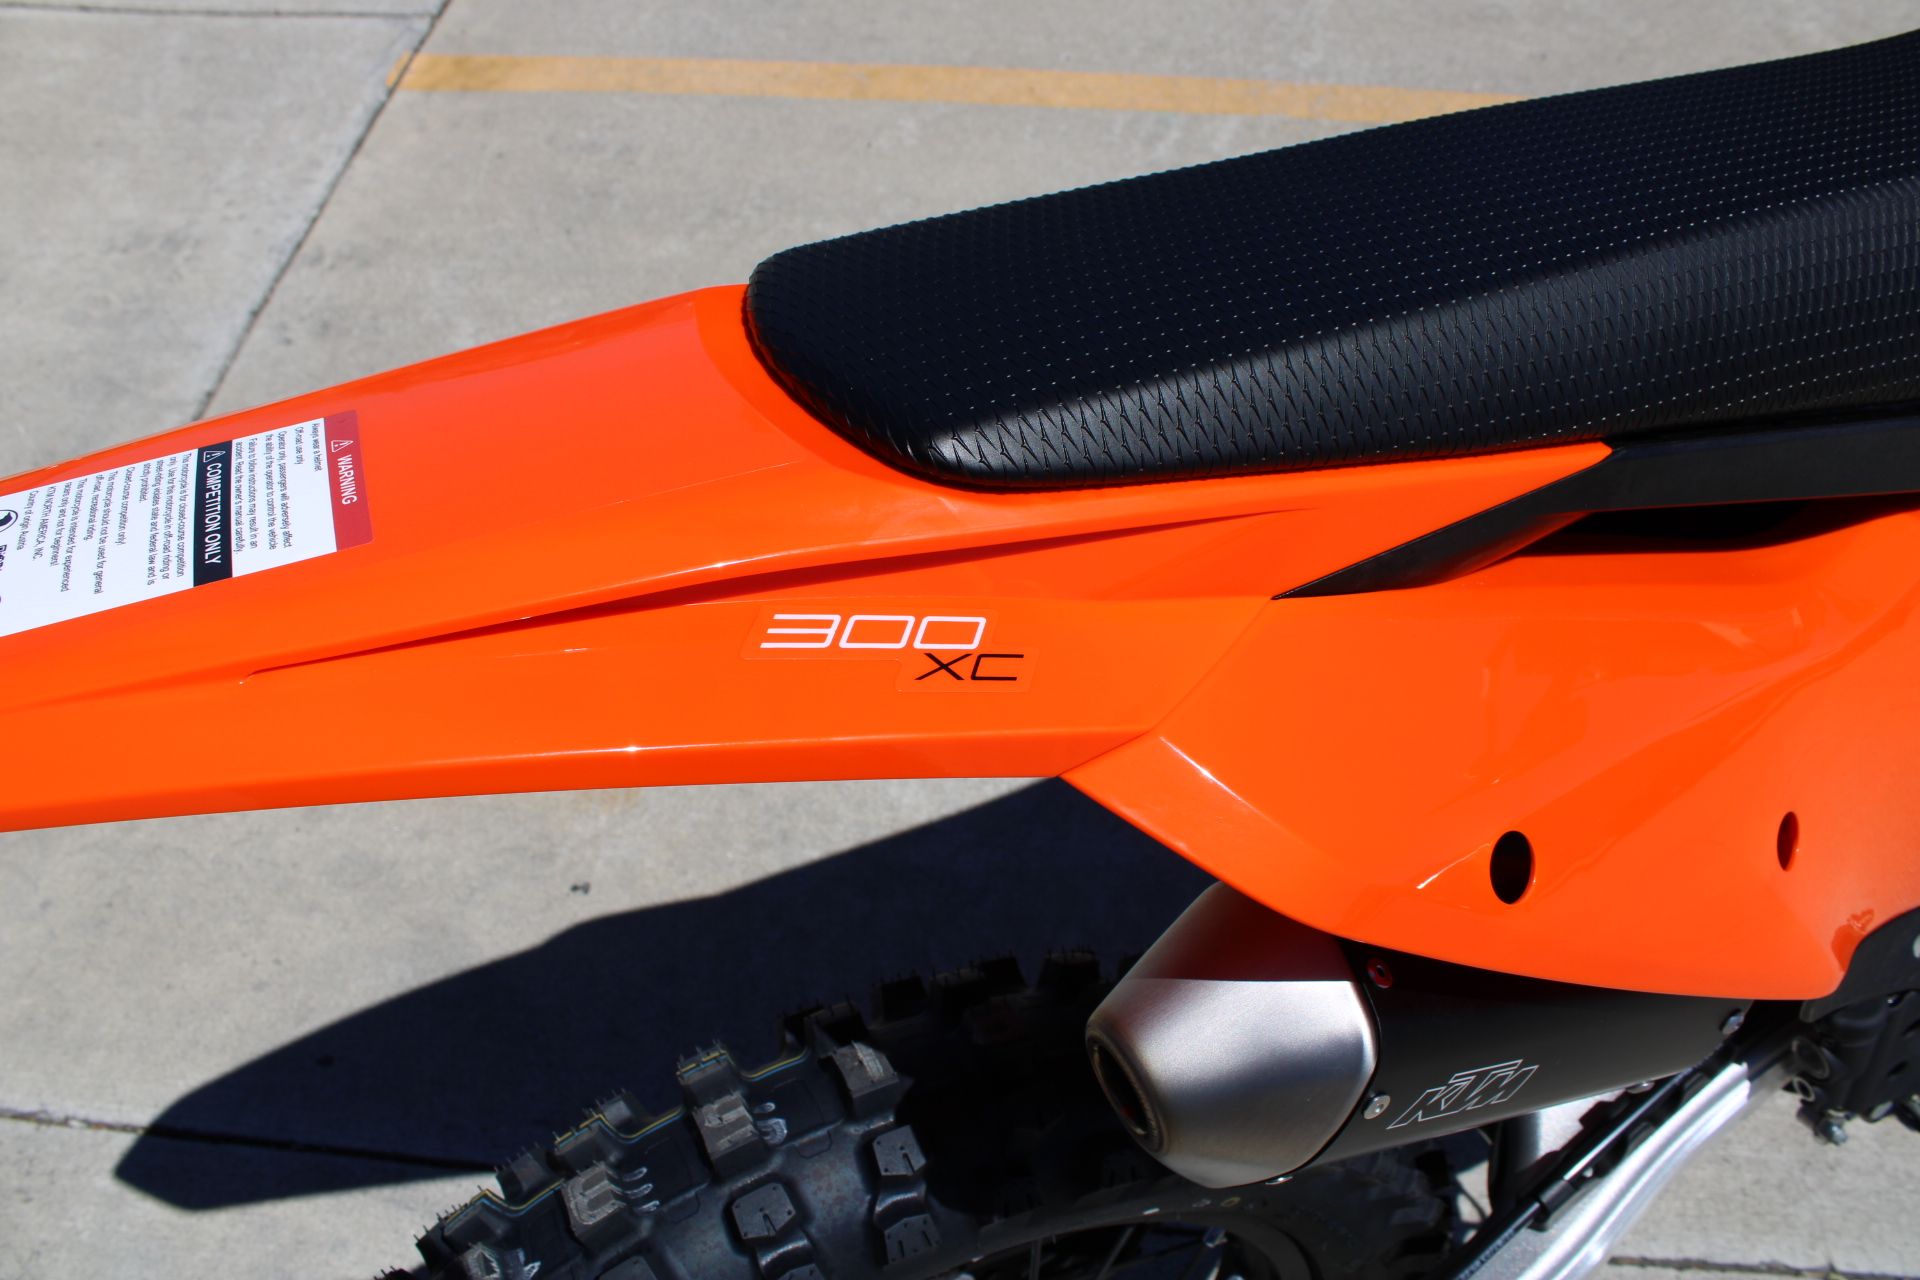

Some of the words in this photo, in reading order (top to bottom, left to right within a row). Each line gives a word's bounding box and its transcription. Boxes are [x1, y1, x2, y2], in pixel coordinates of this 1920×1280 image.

[206, 463, 221, 532] COMPETITION
[338, 455, 357, 504] WARNING
[205, 534, 221, 563] ONLY
[760, 613, 987, 649] 300
[915, 652, 1024, 681] XC
[1386, 1059, 1540, 1130] KTM
